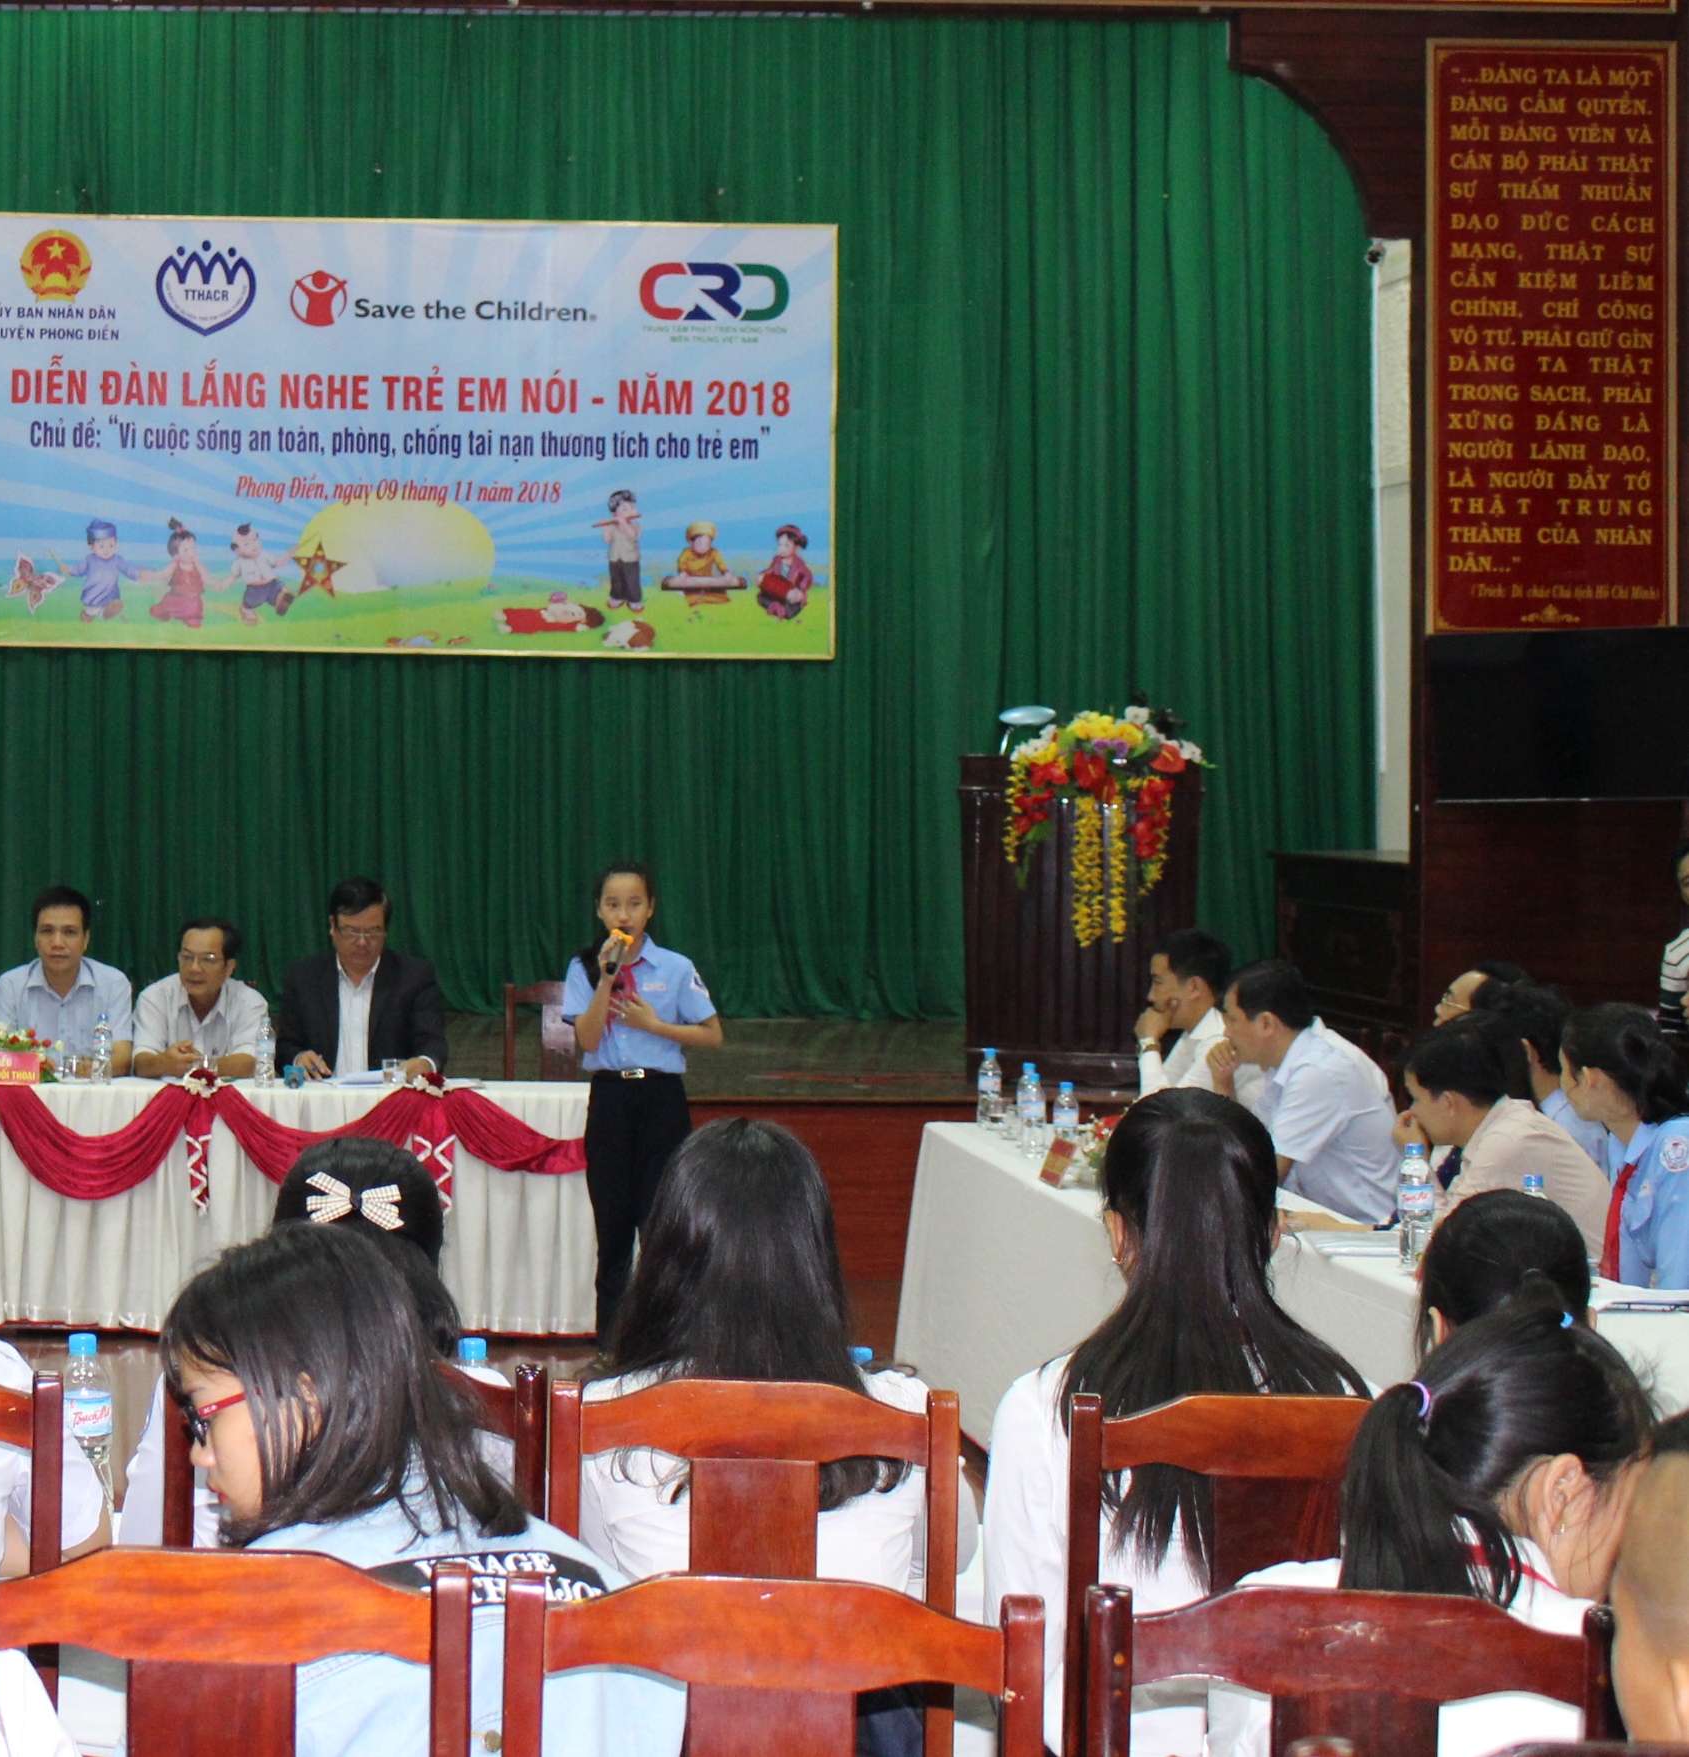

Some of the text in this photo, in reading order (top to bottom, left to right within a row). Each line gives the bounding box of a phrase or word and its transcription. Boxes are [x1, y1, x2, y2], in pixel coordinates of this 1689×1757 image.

[1544, 68, 1571, 85] TA
[1576, 66, 1602, 85] LÀ
[1591, 212, 1654, 233] CÁCH
[185, 289, 228, 301] TTHACR
[18, 308, 43, 318] BAN
[49, 305, 83, 318] NHÂN
[89, 305, 115, 319] DÂN
[355, 299, 414, 318] Save
[424, 301, 465, 319] the
[1542, 298, 1579, 318] CHÍ
[1597, 299, 1653, 320] CÔNG
[40, 329, 83, 339] PHONG
[1538, 356, 1567, 372] TA
[12, 356, 87, 404] DIỄN
[100, 362, 167, 405] ĐÀN
[182, 359, 265, 408] LẮNG
[281, 374, 369, 410] NGHE
[382, 366, 443, 411] TRẺ
[459, 378, 506, 412] EM
[522, 370, 577, 414] NÓI
[619, 373, 692, 414] NĂM
[707, 381, 789, 416] 2018
[1448, 384, 1520, 401] TRONG
[31, 418, 65, 447] Chủ
[73, 418, 100, 448] đề:
[144, 423, 189, 456] cuộc
[197, 421, 241, 454] sống
[249, 430, 270, 451] an
[278, 426, 324, 455] toàn,
[332, 427, 395, 457] phòng,
[404, 425, 461, 458] chống
[469, 430, 491, 455] tai
[500, 435, 533, 462] nạn
[541, 431, 605, 461] thương
[613, 432, 648, 458] tích
[656, 433, 690, 458] cho
[697, 430, 722, 459] trẻ
[236, 476, 285, 504] Phong
[333, 484, 373, 505] ngày
[377, 479, 398, 500] 09
[402, 479, 448, 507] tháng
[455, 481, 472, 501] 11
[478, 482, 513, 502] năm
[517, 482, 561, 502] 2018
[1557, 499, 1652, 516] TRUNG
